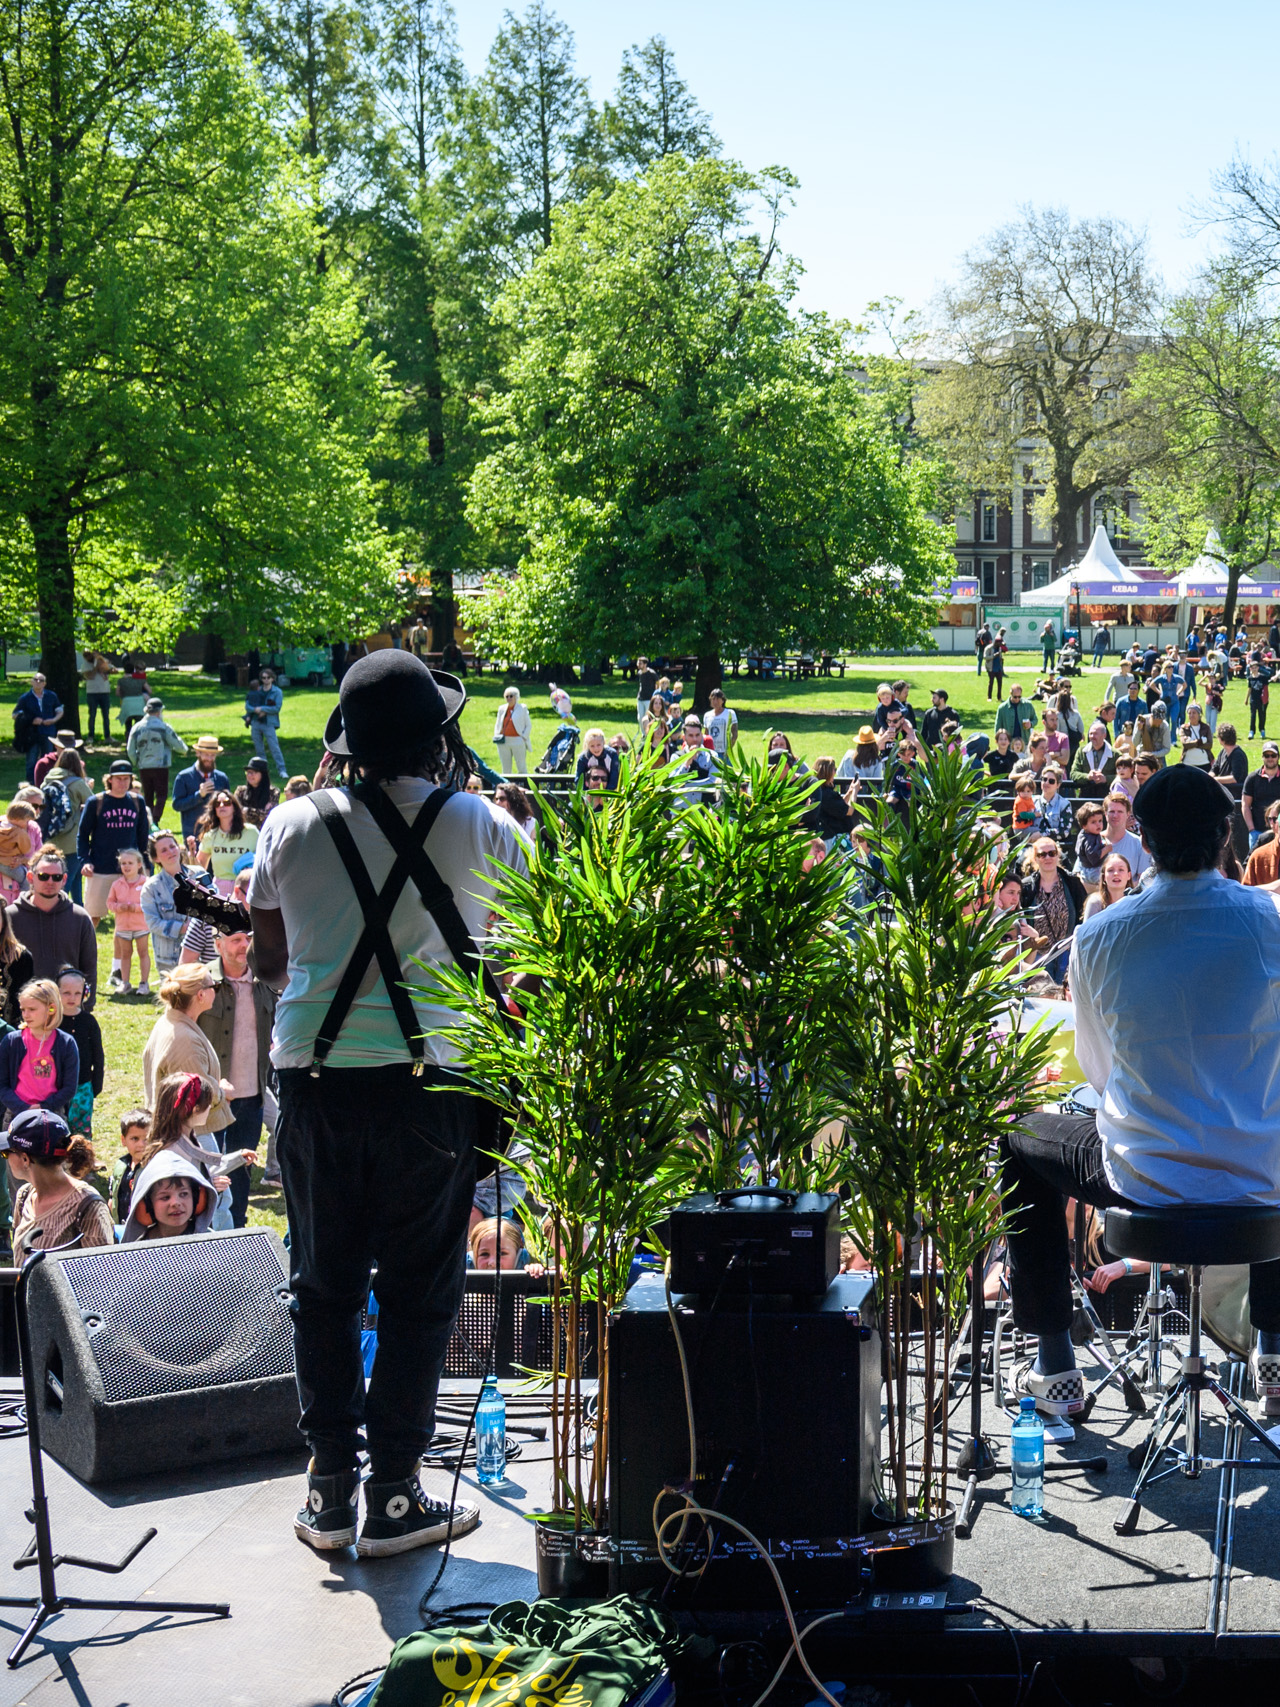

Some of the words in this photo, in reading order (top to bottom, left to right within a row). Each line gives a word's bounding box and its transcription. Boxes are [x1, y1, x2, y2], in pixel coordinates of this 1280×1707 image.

[1111, 585, 1138, 593] KEBAB
[1215, 586, 1262, 594] VIEAMEES
[106, 808, 137, 819] PATRON
[12, 1135, 33, 1146] CarNext
